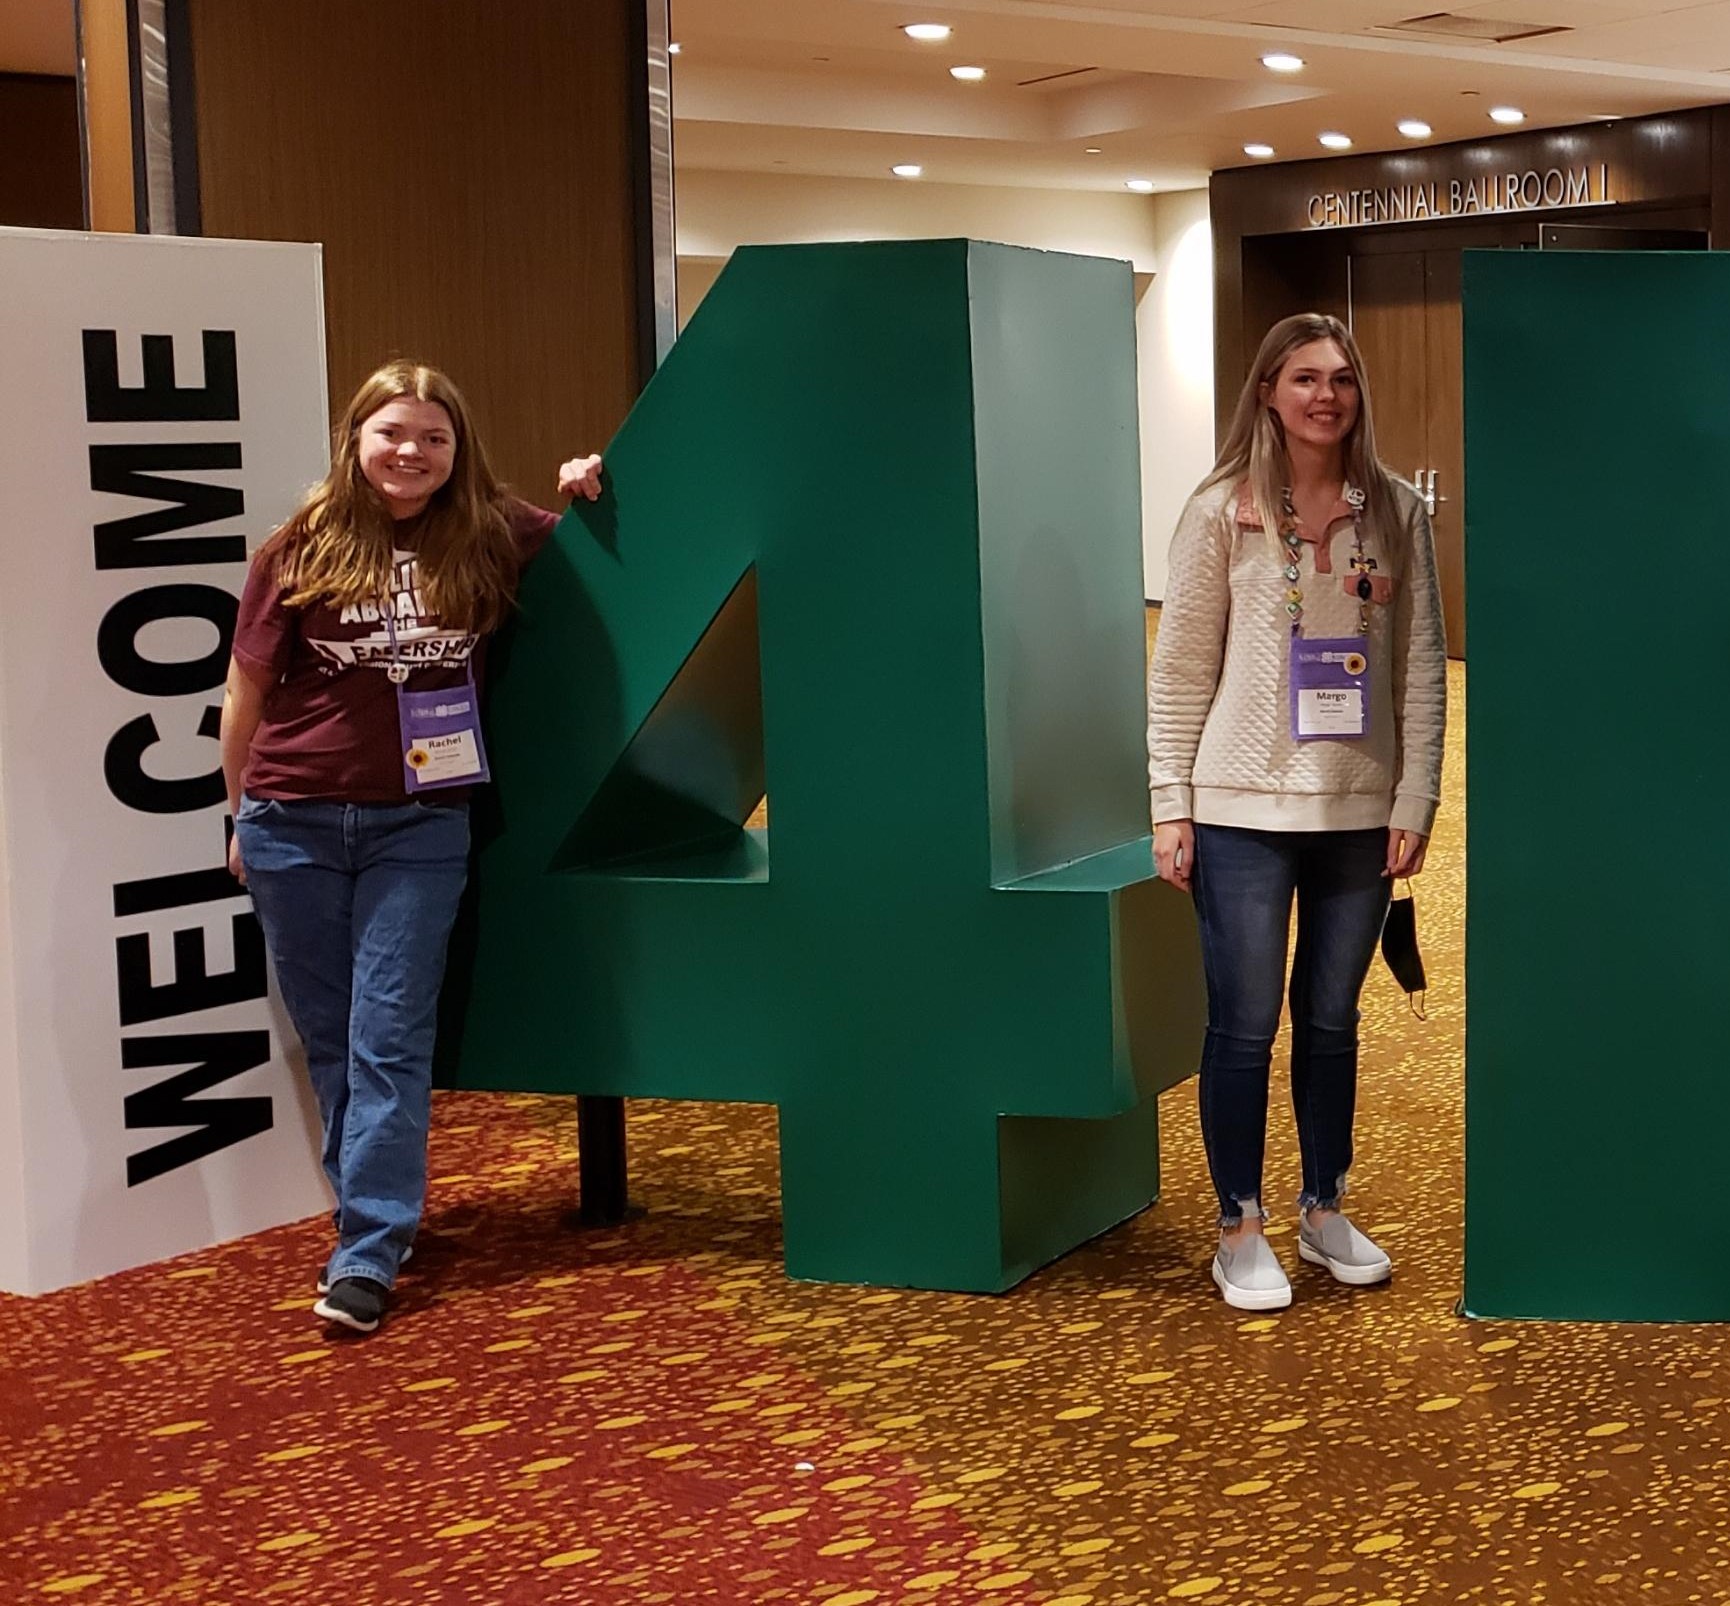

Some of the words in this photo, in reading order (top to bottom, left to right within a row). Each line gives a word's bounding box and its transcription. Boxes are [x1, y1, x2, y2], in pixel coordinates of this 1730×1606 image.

[1308, 181, 1442, 228] CENTENNIAL
[1449, 166, 1589, 215] BALLROOM
[340, 589, 440, 624] ABOA
[1316, 691, 1348, 703] Margo
[82, 328, 274, 1188] WELCOME
[428, 735, 463, 750] Rachel
